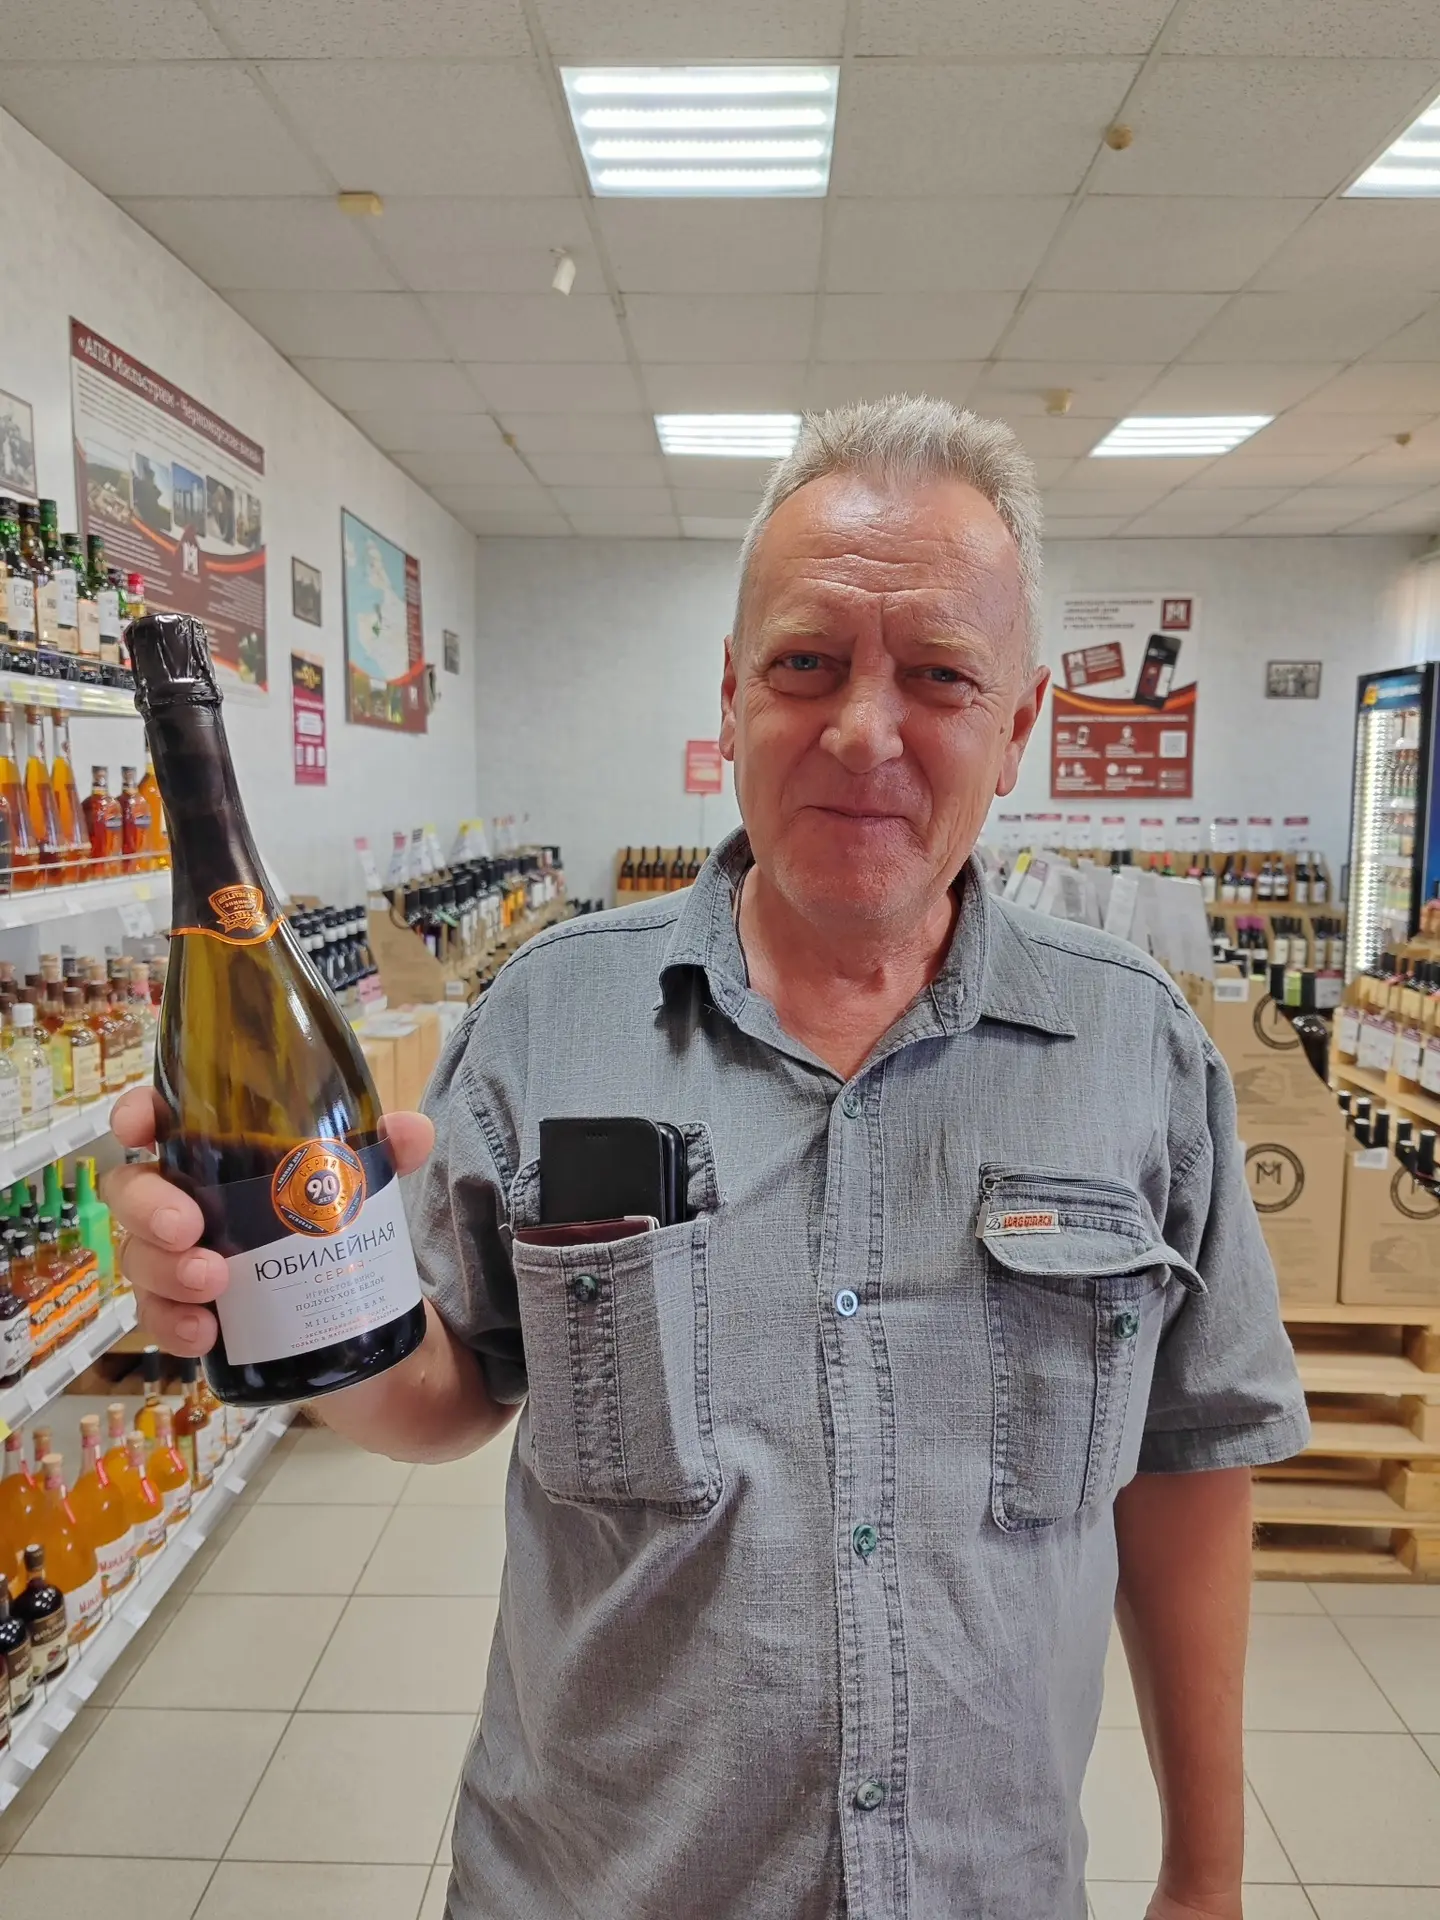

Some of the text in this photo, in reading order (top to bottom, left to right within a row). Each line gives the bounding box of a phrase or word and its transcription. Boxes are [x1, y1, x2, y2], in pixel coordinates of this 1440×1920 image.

[306, 1175, 337, 1200] 90
[318, 1195, 332, 1204] ЛЕТ
[254, 1221, 396, 1282] ЮБИЛЕЙНАЯ
[295, 1275, 386, 1312] ПОЛУСУХОЕ БЕЛОЕ
[304, 1295, 387, 1329] MILLSTREAM
